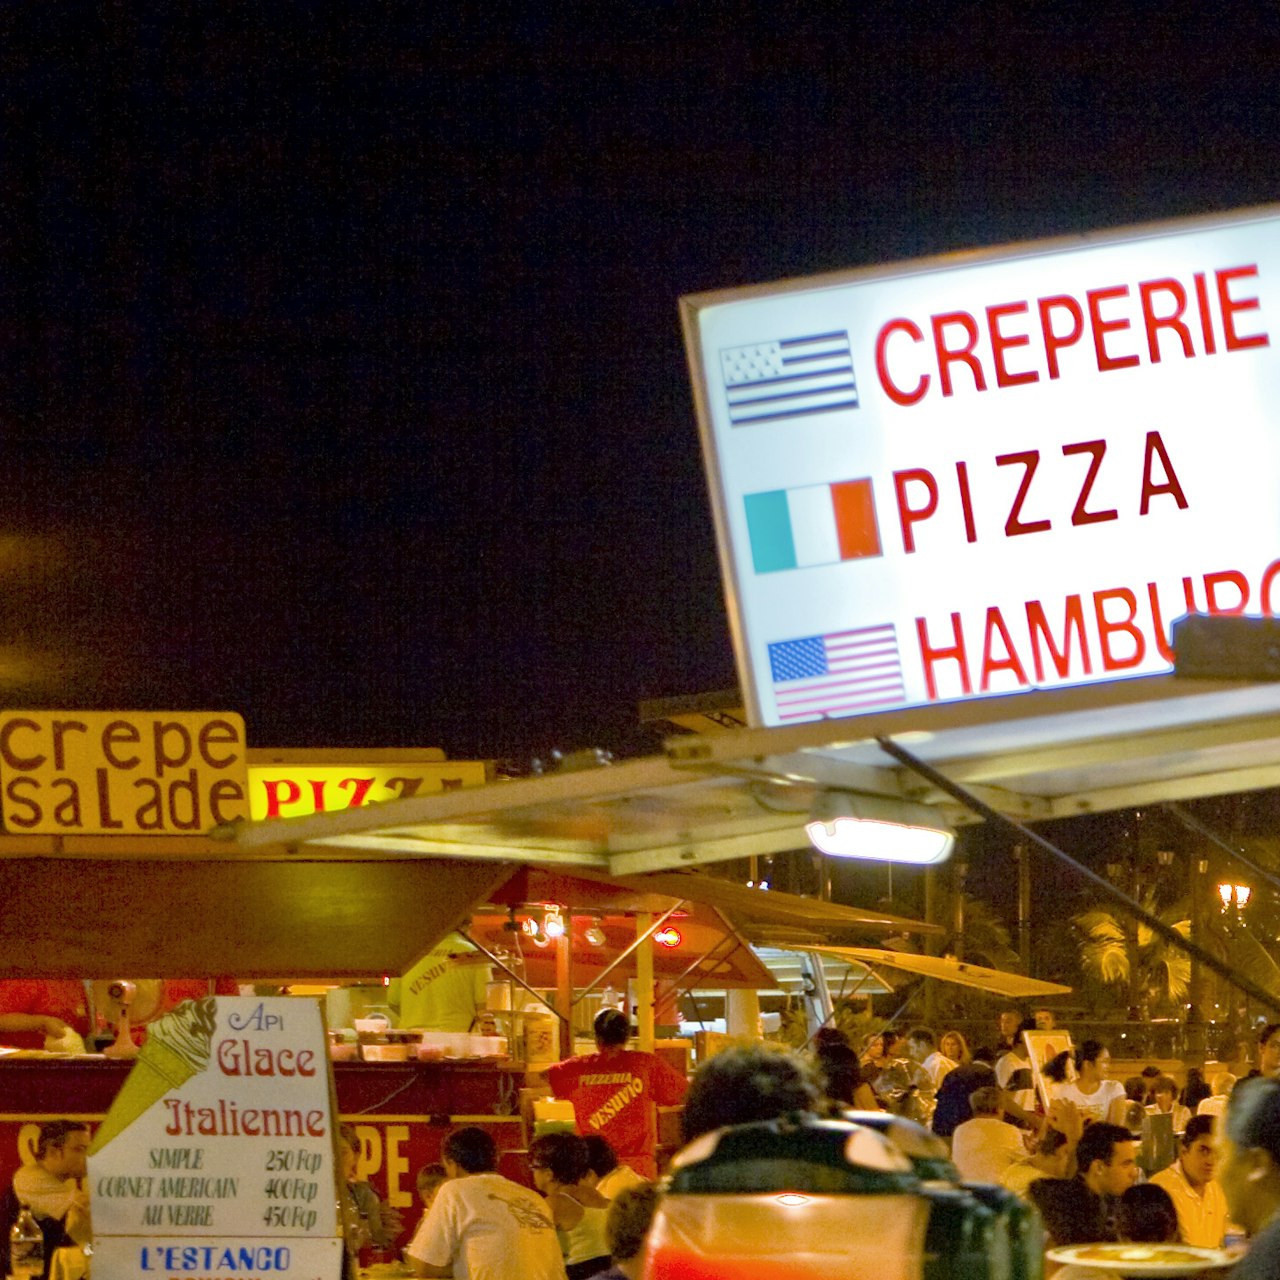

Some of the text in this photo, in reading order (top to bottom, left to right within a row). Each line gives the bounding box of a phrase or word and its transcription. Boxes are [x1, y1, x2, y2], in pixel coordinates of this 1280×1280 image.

[874, 263, 1271, 408] CREPERIE
[892, 430, 1189, 554] PIZZA
[0, 717, 239, 777] crepe
[7, 768, 245, 831] salade
[217, 1039, 317, 1077] Glace
[164, 1099, 326, 1138] Italienne
[589, 1077, 643, 1130] VESUVIO
[149, 1149, 204, 1170] SIMPLE
[97, 1176, 155, 1198] CORNET
[158, 1176, 239, 1199] AMERICAIN
[166, 1205, 214, 1227] VERRE
